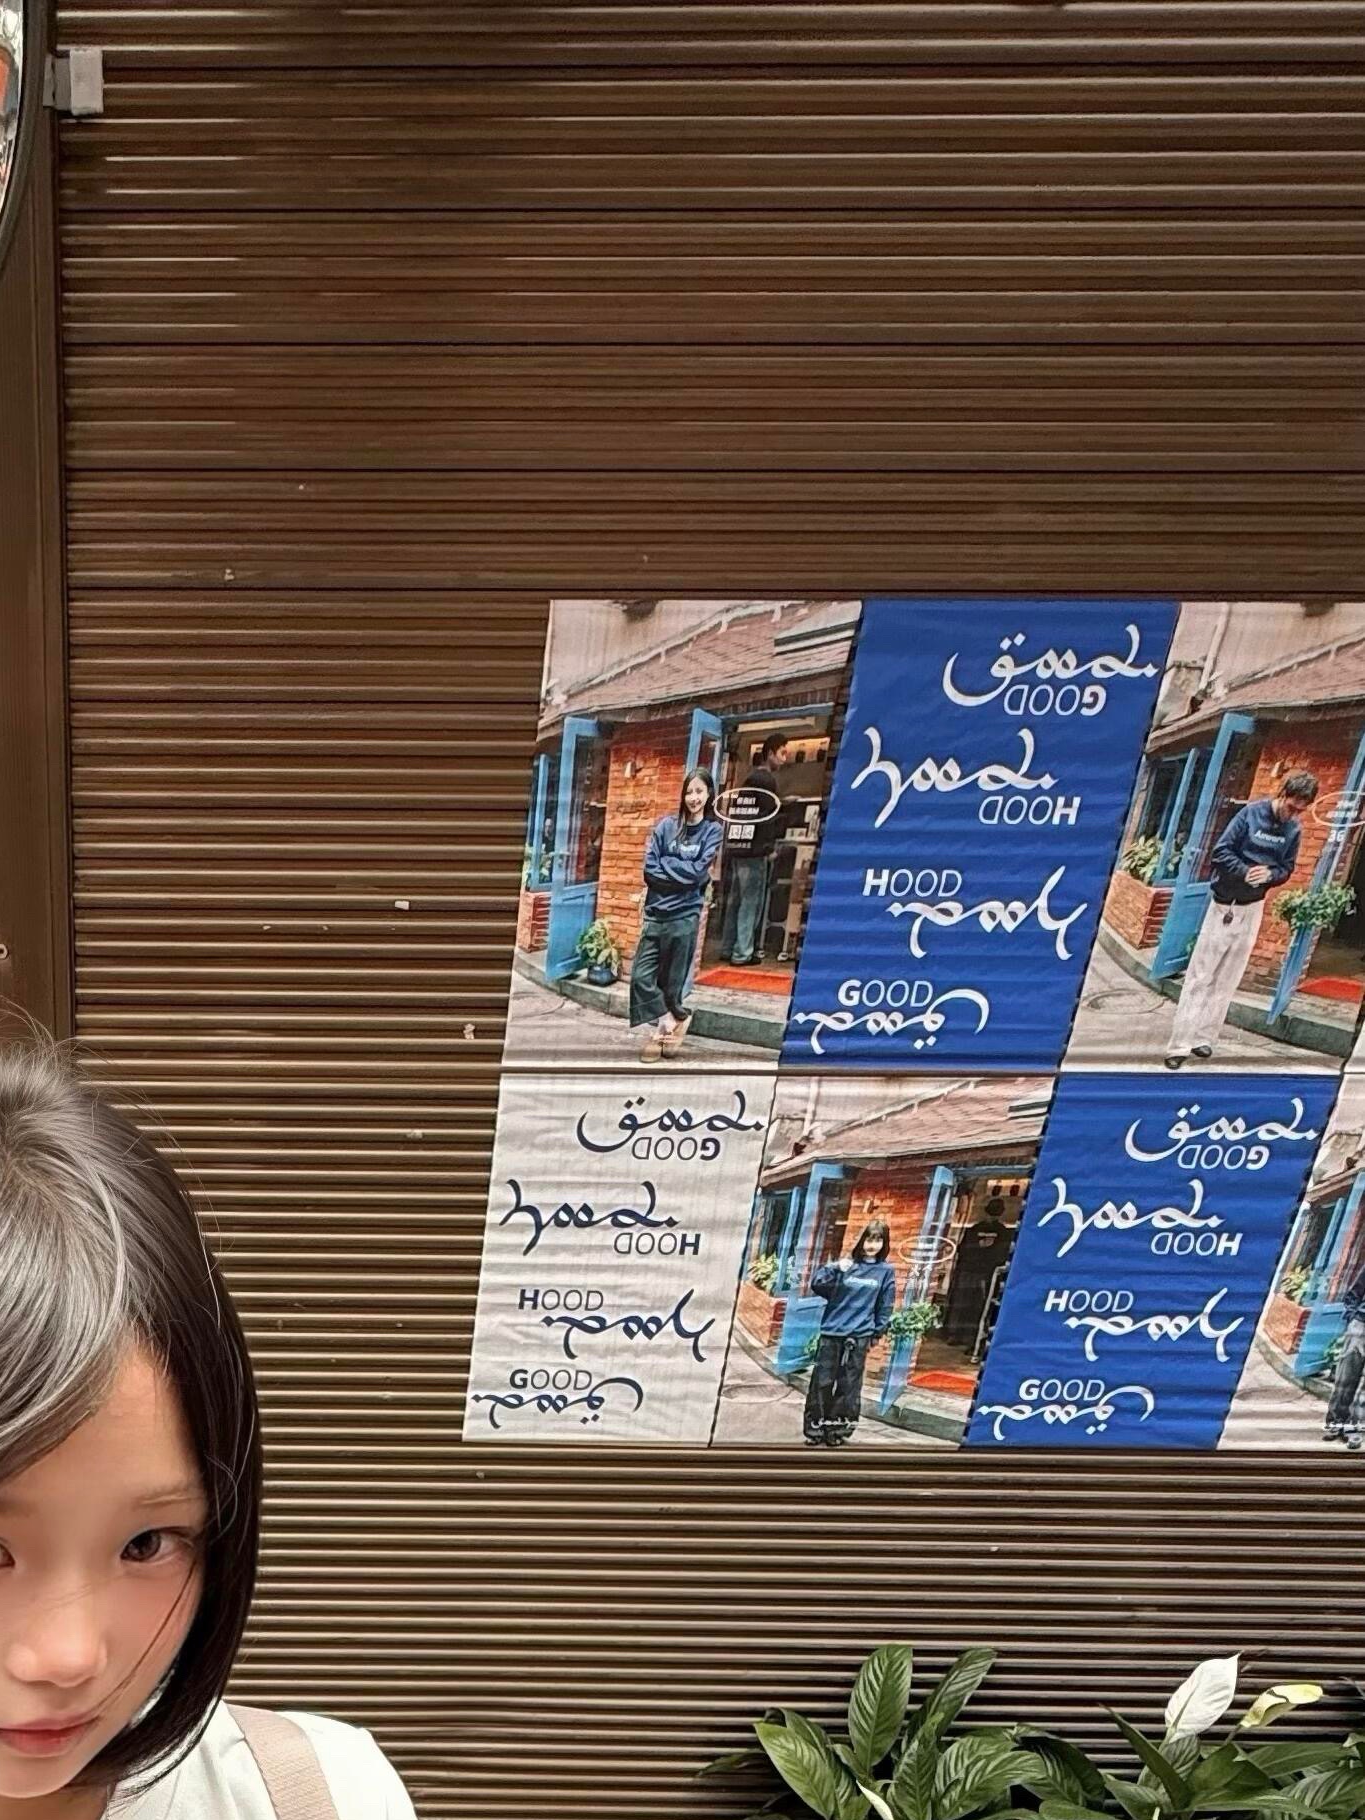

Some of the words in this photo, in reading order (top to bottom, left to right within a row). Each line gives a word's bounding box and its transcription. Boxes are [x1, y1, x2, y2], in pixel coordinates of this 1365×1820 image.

[1003, 684, 1107, 716] GOOD
[978, 795, 1081, 826] HOOD
[862, 868, 963, 898] HOOD
[837, 979, 934, 1008] GOOD
[631, 1136, 721, 1161] GOOD
[1177, 1144, 1270, 1170] GOOD
[613, 1232, 702, 1256] HOOD
[1150, 1232, 1243, 1257] HOOD
[518, 1288, 604, 1311] HOOD
[1044, 1289, 1133, 1313] HOOD
[509, 1368, 592, 1391] GOOD
[1019, 1379, 1105, 1401] GOOD
